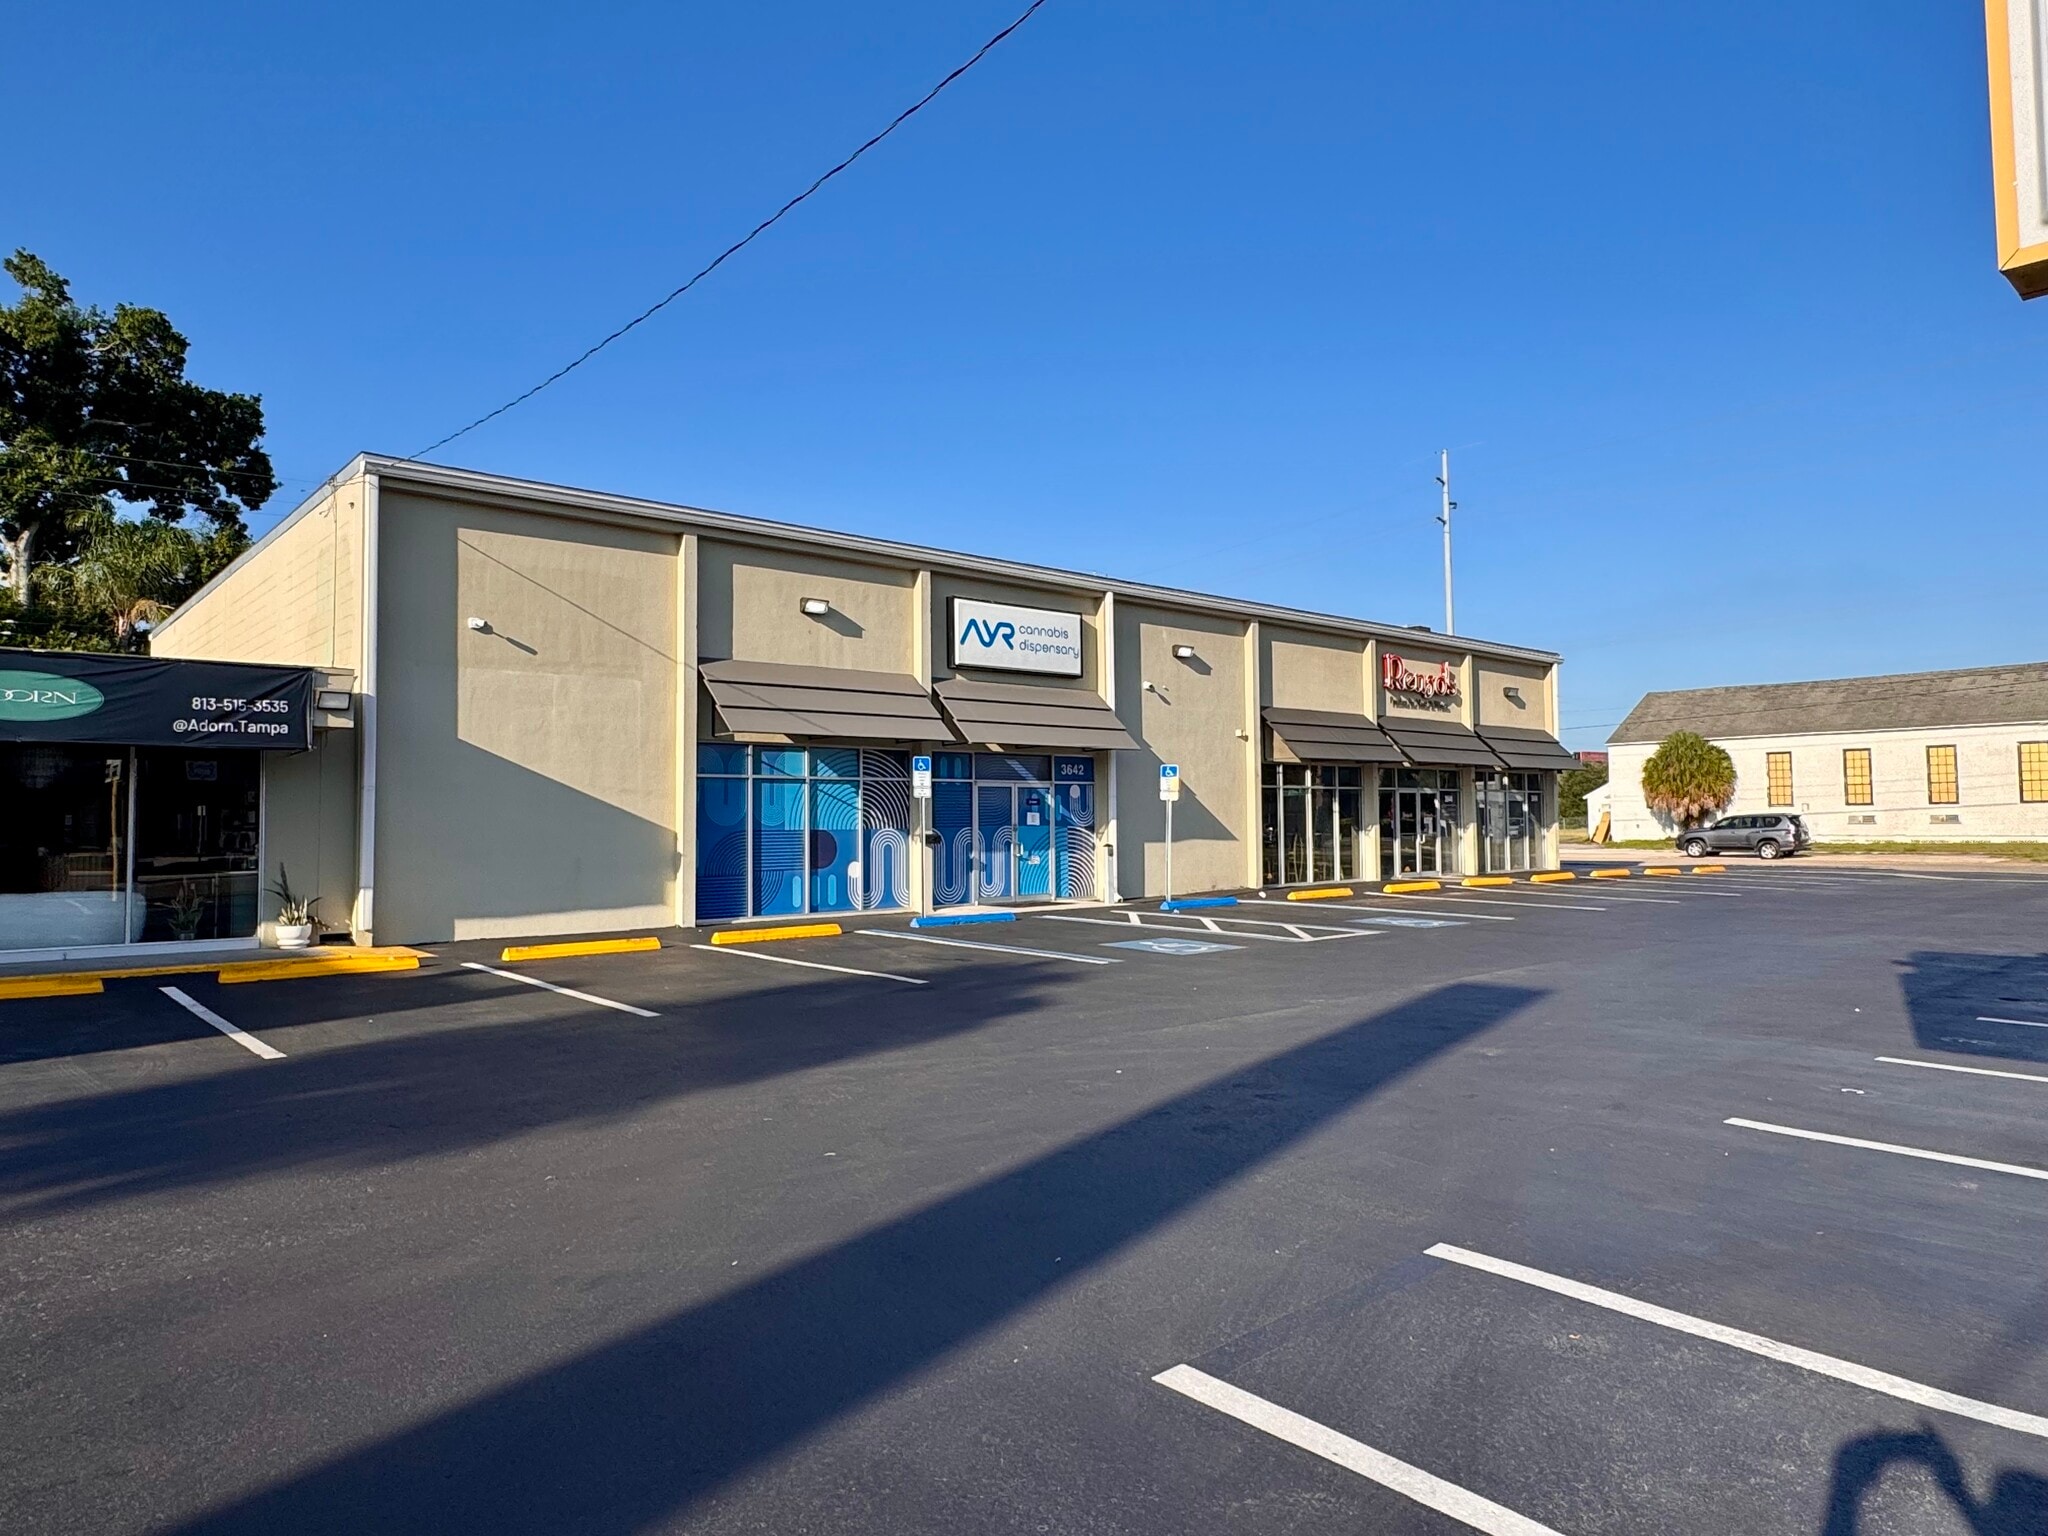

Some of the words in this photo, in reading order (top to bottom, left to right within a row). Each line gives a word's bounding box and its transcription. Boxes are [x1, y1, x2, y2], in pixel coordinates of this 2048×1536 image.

[960, 618, 1015, 651] AYR
[1019, 625, 1069, 640] cannabis
[1019, 640, 1079, 660] dispensary
[1382, 653, 1457, 699] Renzo's
[191, 696, 289, 714] 813-515-3535
[172, 718, 289, 737] @Adorn.Tampa
[1060, 763, 1085, 776] 3642
